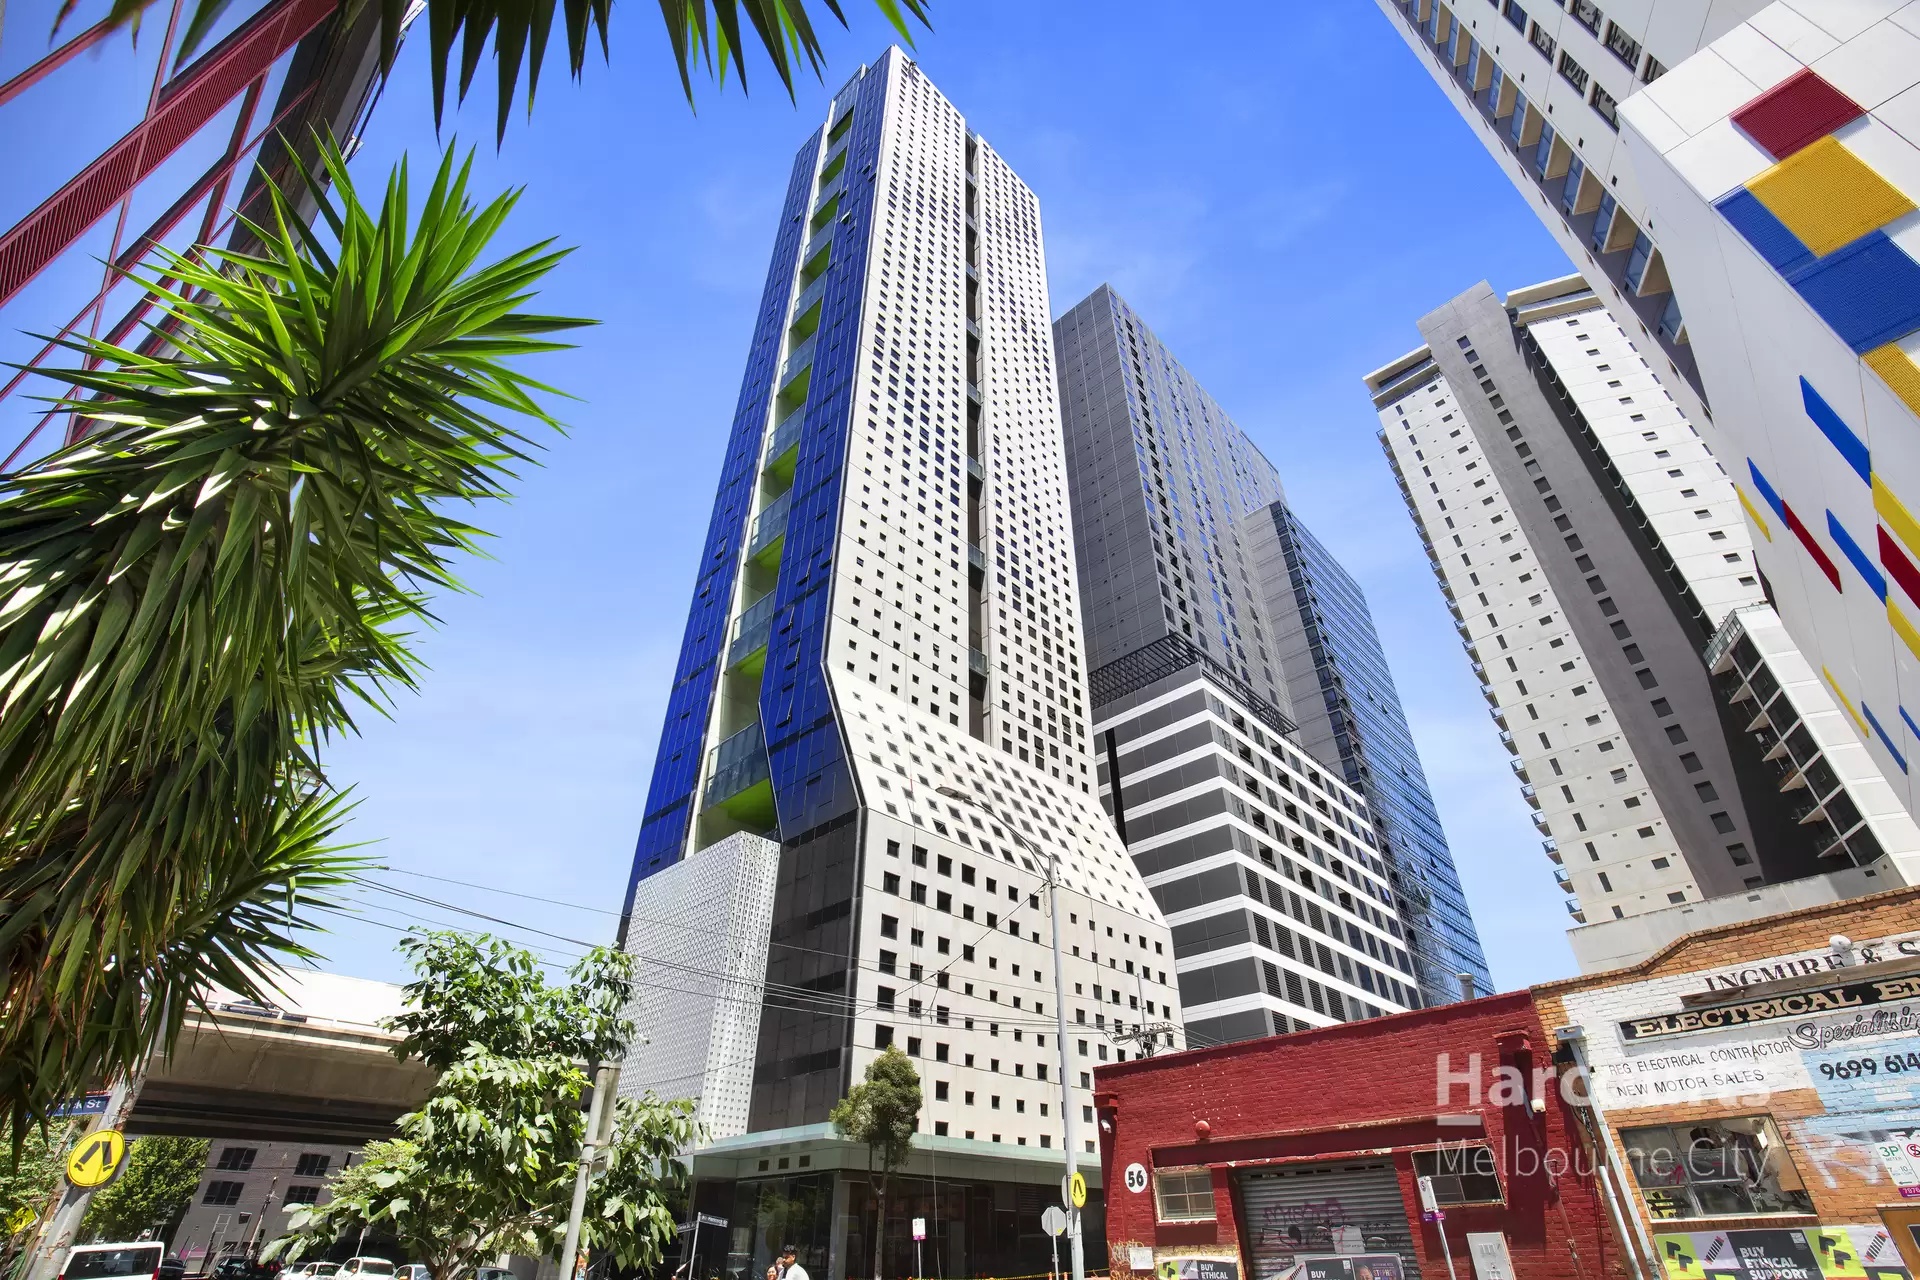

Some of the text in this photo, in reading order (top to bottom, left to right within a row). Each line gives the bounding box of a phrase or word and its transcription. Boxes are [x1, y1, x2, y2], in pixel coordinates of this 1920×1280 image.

[1630, 988, 1863, 1038] ELECTRICAL
[1608, 1040, 1793, 1077] REG ELECTRICAL CONTRACTOR
[1819, 1052, 1920, 1081] 9699 614
[1616, 1069, 1765, 1097] NEW MOTOR SALES
[86, 1099, 101, 1109] St
[1879, 1145, 1899, 1157] 3P
[1128, 1170, 1145, 1187] 56
[1739, 1246, 1765, 1258] BUY
[1200, 1263, 1214, 1272] BUY
[1744, 1257, 1797, 1269] ETHICAL
[1201, 1271, 1229, 1280] ETHICAL
[1310, 1270, 1326, 1279] BUY
[1749, 1268, 1809, 1280] SUPPORT
